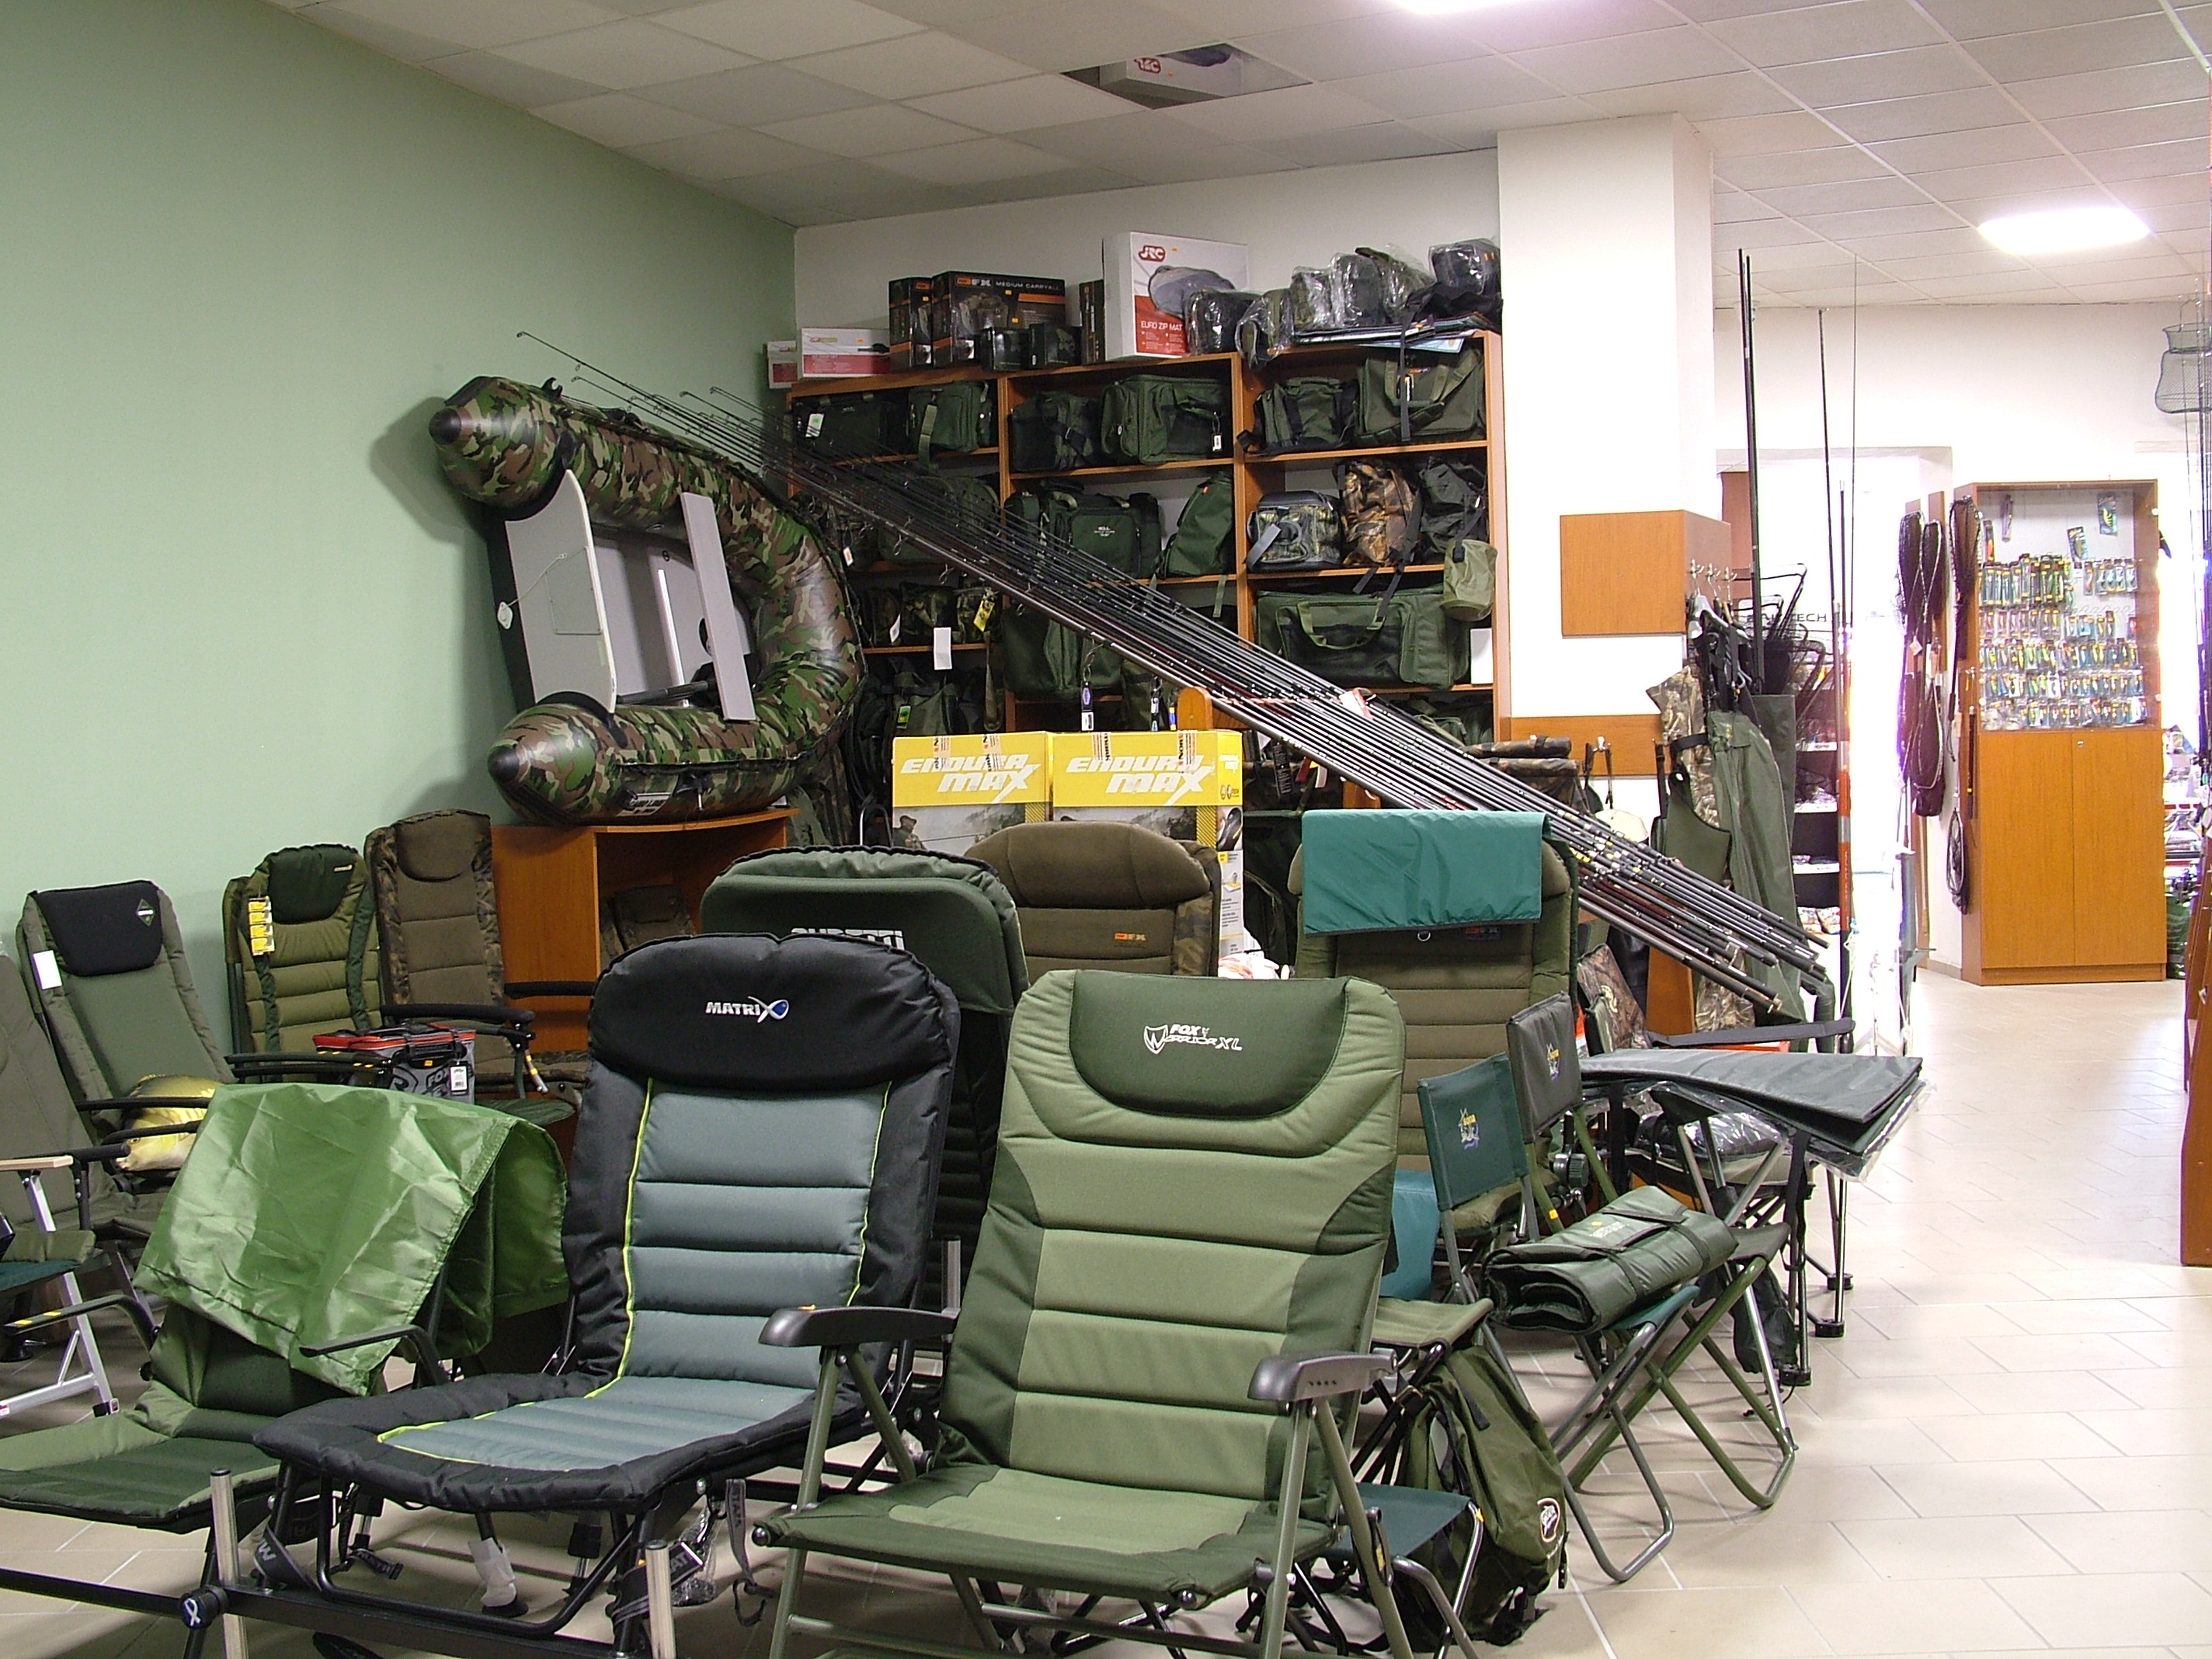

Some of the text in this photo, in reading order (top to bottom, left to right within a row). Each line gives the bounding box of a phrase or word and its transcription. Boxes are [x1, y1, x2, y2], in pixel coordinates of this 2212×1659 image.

[1139, 246, 1165, 261] JRC
[1140, 320, 1158, 329] EURO
[900, 753, 1030, 774] ENDURA
[937, 763, 1042, 805] MAX
[1104, 764, 1216, 807] MAX
[704, 996, 790, 1024] MATRIX
[1169, 1024, 1202, 1036] FOX
[1214, 1037, 1243, 1051] XL
